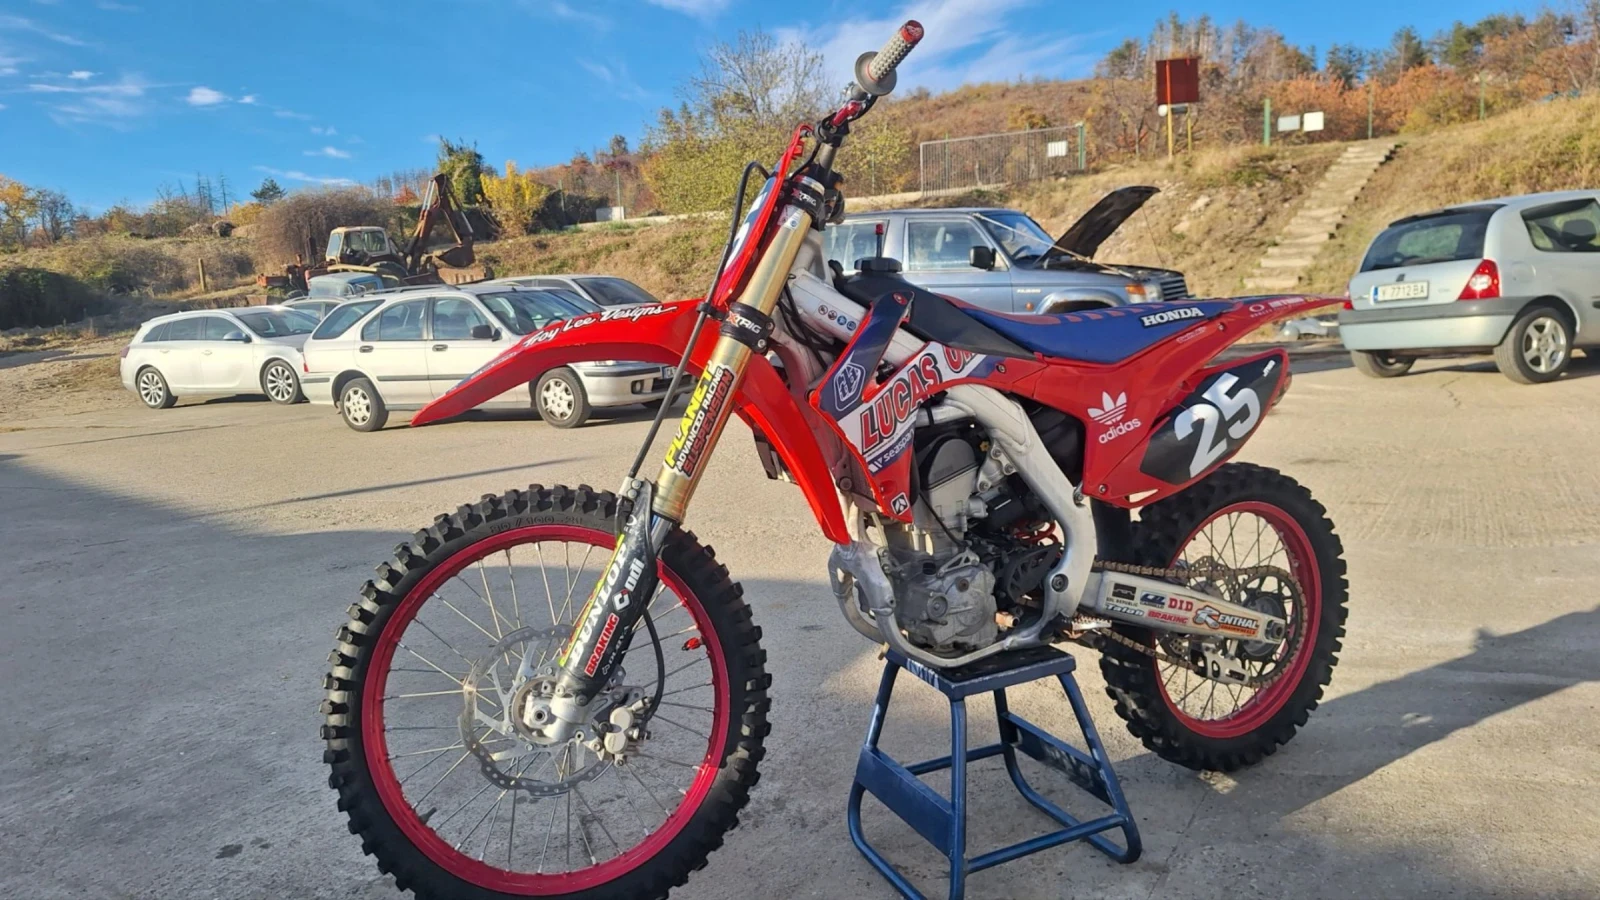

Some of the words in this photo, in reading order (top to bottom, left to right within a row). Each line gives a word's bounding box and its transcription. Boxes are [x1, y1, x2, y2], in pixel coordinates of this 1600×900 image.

[1141, 307, 1205, 327] HONDA
[1390, 285, 1412, 299] 7712
[523, 328, 559, 348] Troy
[562, 316, 596, 332] Lee
[600, 304, 678, 322] Designs
[664, 360, 714, 469] PLANET
[676, 410, 706, 472] ADVANCED
[702, 365, 724, 410] RACING
[682, 367, 734, 477] SUSPENSION
[860, 352, 942, 456] LUCAS
[1098, 417, 1142, 444] adidas
[1174, 372, 1261, 478] 25
[569, 541, 627, 668] DUNLOP
[1147, 608, 1189, 625] BRAKING
[1167, 597, 1194, 612] DID
[584, 612, 619, 677] BRAKING
